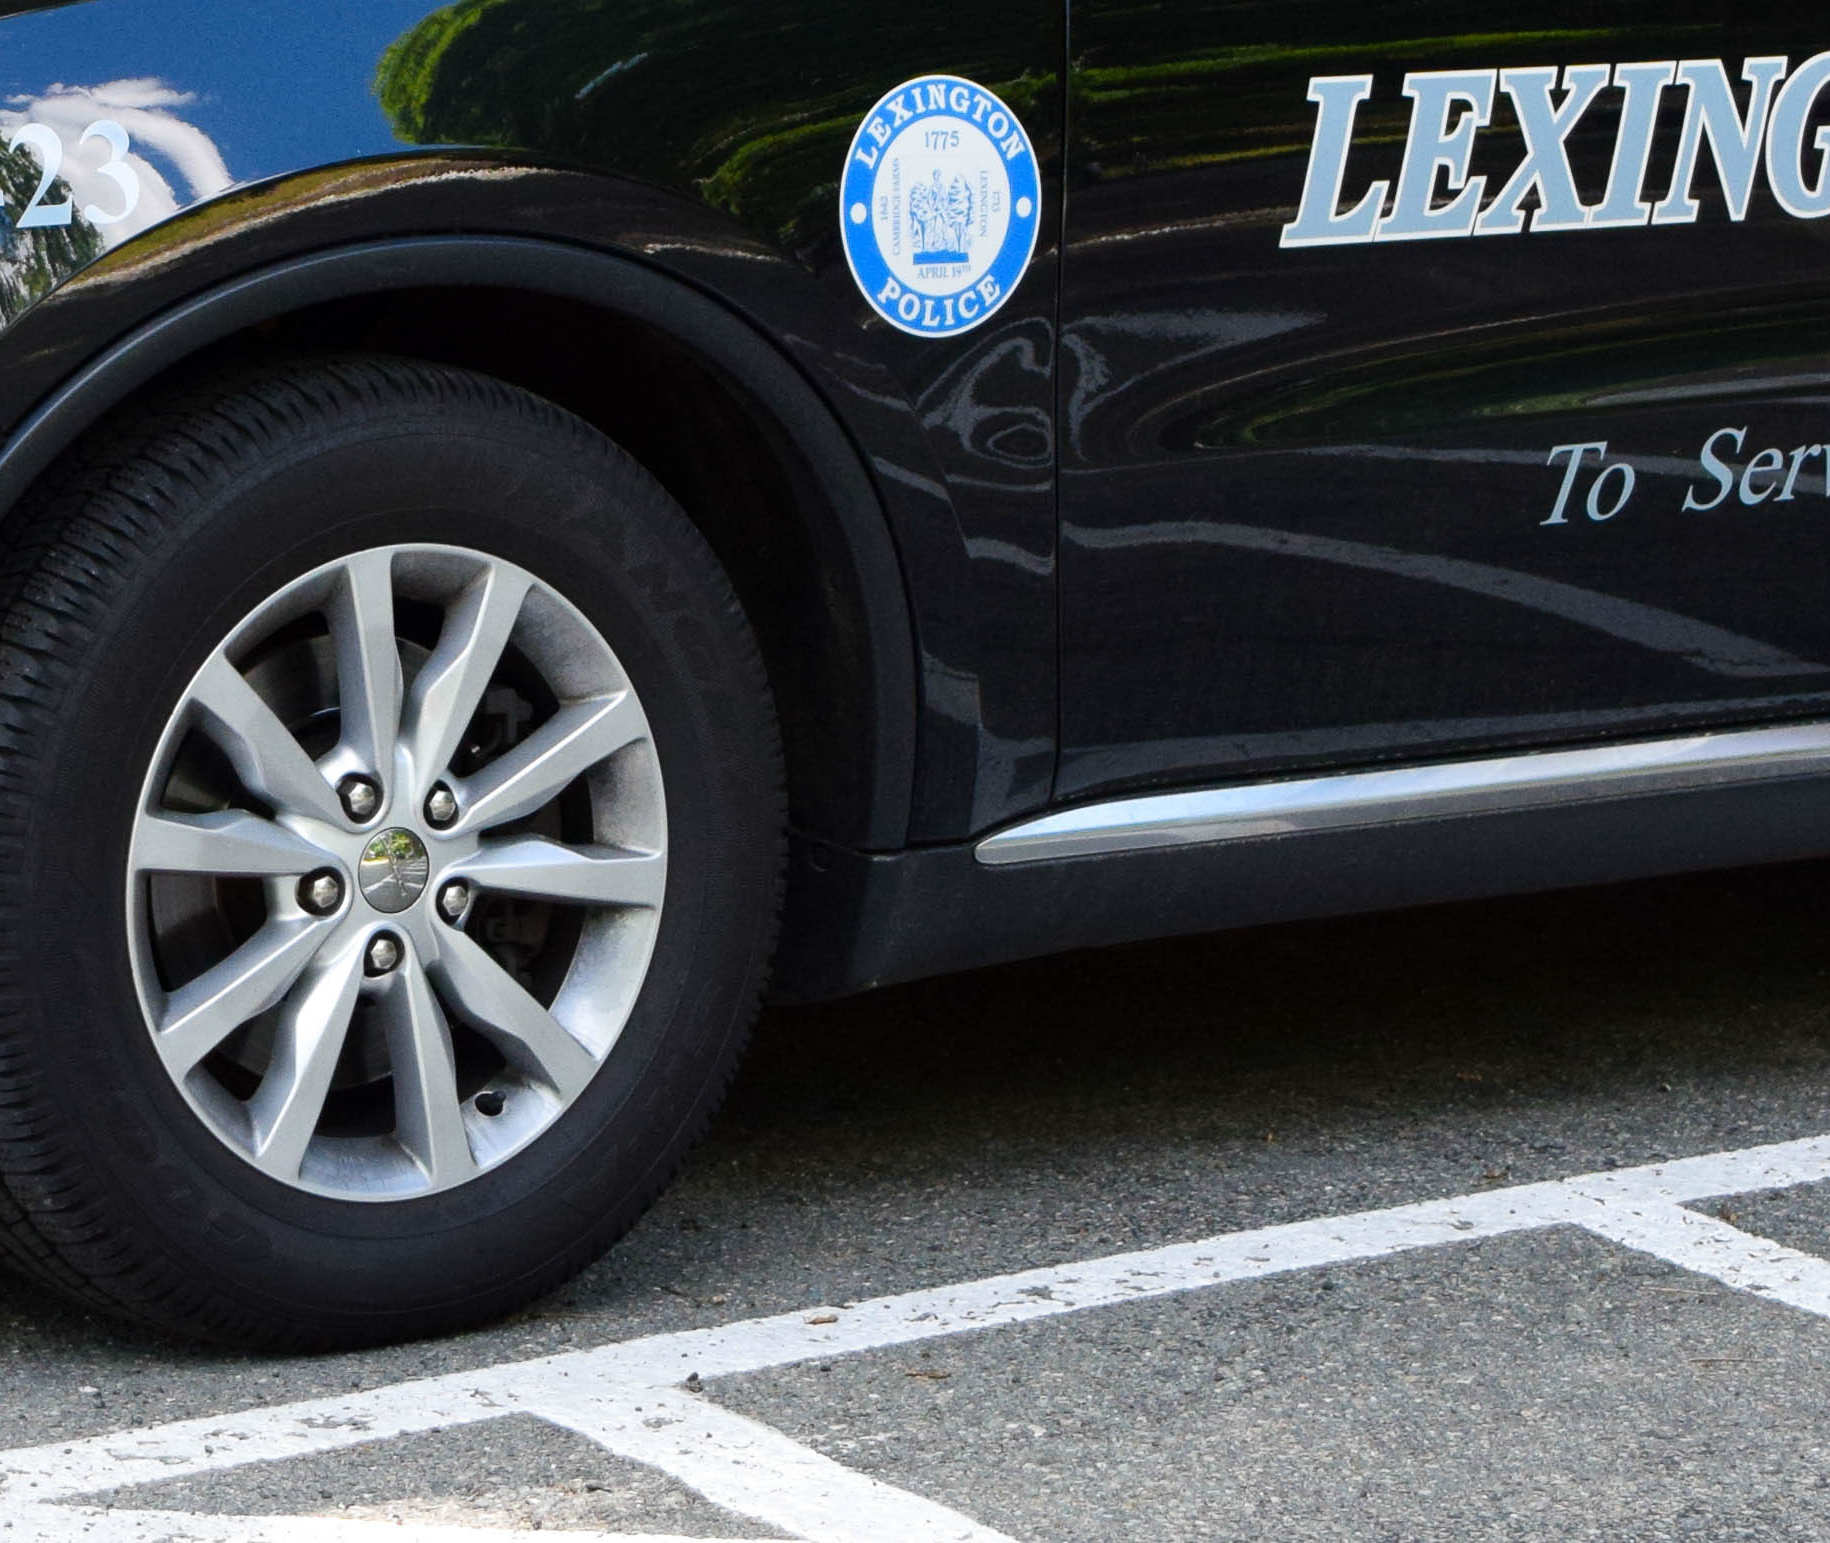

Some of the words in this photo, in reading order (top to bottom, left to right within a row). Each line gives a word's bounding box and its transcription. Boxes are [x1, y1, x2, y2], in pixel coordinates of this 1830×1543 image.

[856, 83, 1026, 169] LEXINGTON
[924, 130, 960, 151] 1775
[877, 276, 1001, 327] POLICE
[1540, 440, 1637, 527] To
